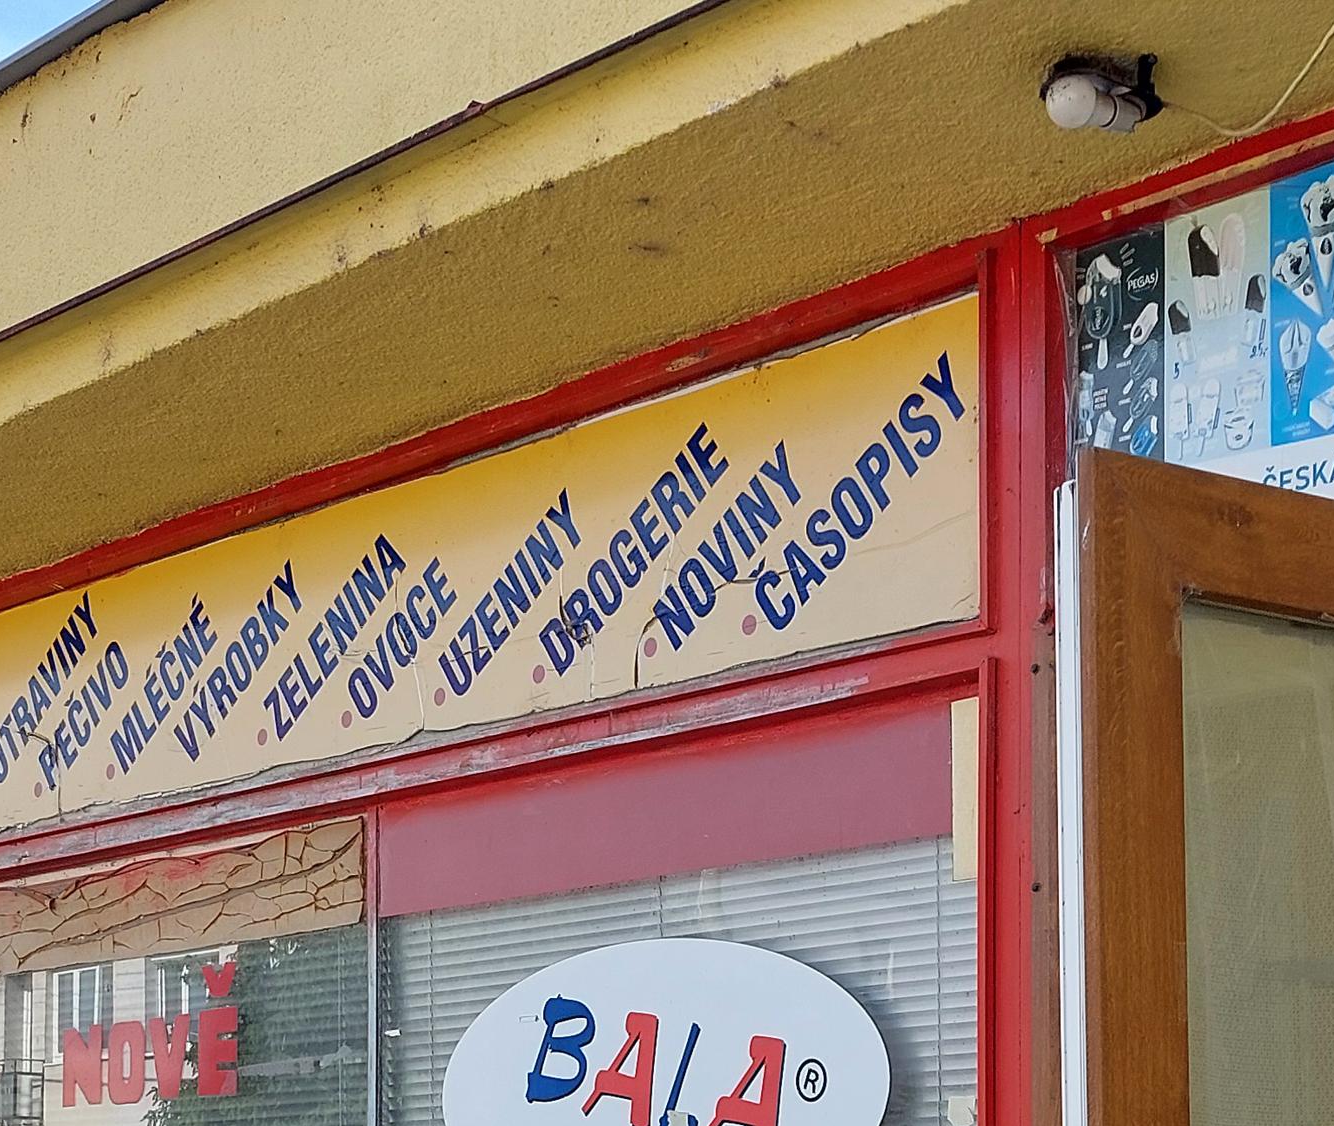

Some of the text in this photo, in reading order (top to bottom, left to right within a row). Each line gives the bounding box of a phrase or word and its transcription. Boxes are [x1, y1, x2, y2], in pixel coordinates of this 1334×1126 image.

[1127, 272, 1156, 291] PEGAS
[436, 487, 585, 698] UZENINY
[538, 422, 731, 678] DROGERIE
[653, 440, 803, 652] NOVINY
[754, 350, 968, 632] ČASOPISY
[38, 641, 130, 792] PEČIVO
[109, 592, 218, 775] MLÉČNÉ
[172, 558, 304, 763] VÝROBKY
[263, 533, 407, 742] ZELENINA
[347, 557, 458, 720] OVOCE
[63, 962, 238, 1107] NOVĚ
